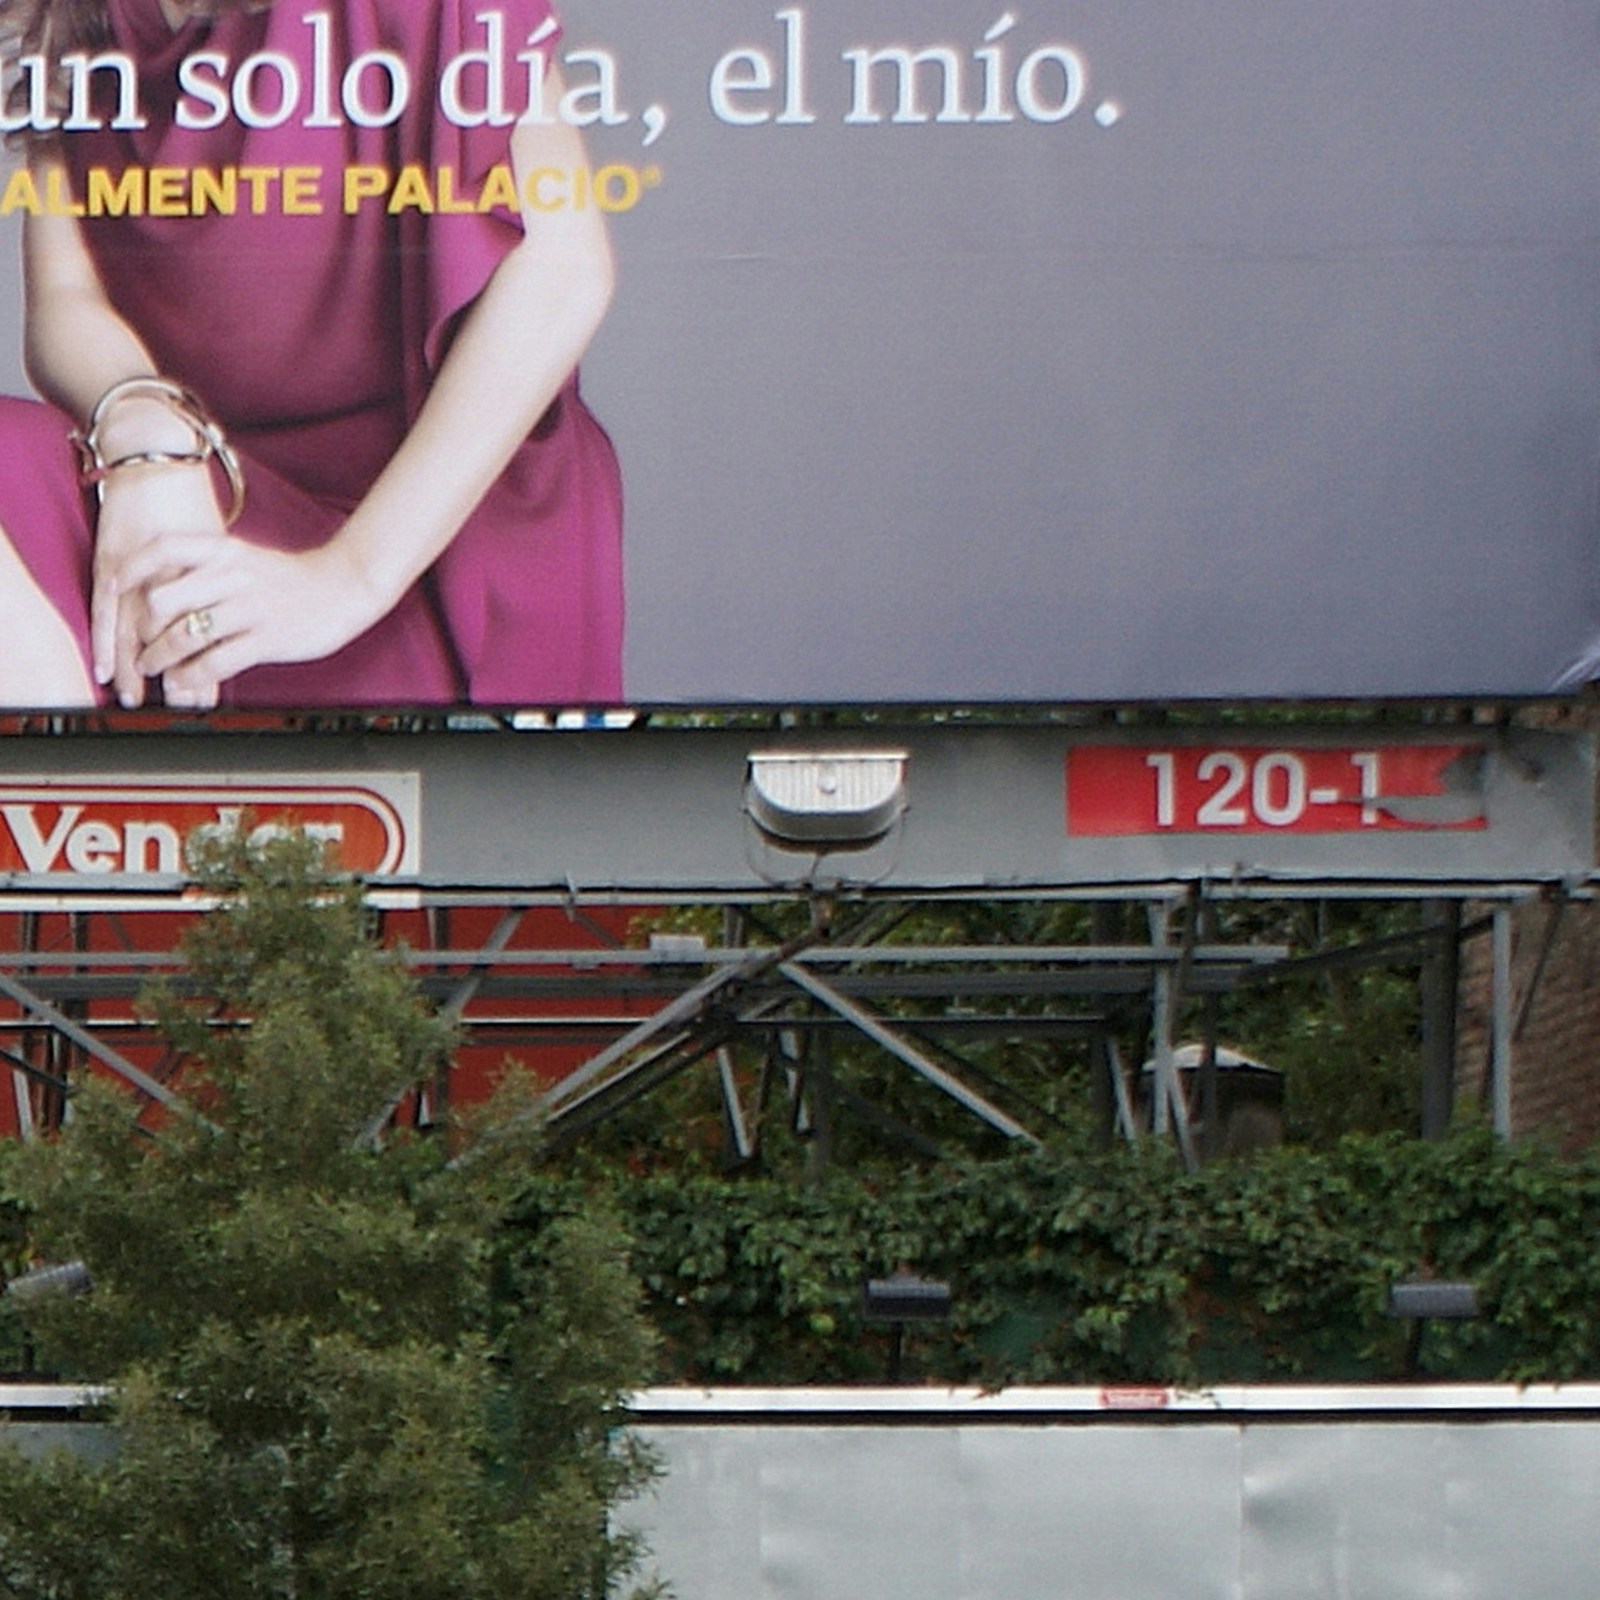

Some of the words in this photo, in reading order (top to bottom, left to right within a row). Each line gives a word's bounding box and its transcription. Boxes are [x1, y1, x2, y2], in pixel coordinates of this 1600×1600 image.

[175, 12, 410, 130] solo
[440, 11, 666, 147] día,
[709, 9, 815, 127] el
[842, 12, 1119, 127] mío.
[1146, 752, 1380, 827] 120-1
